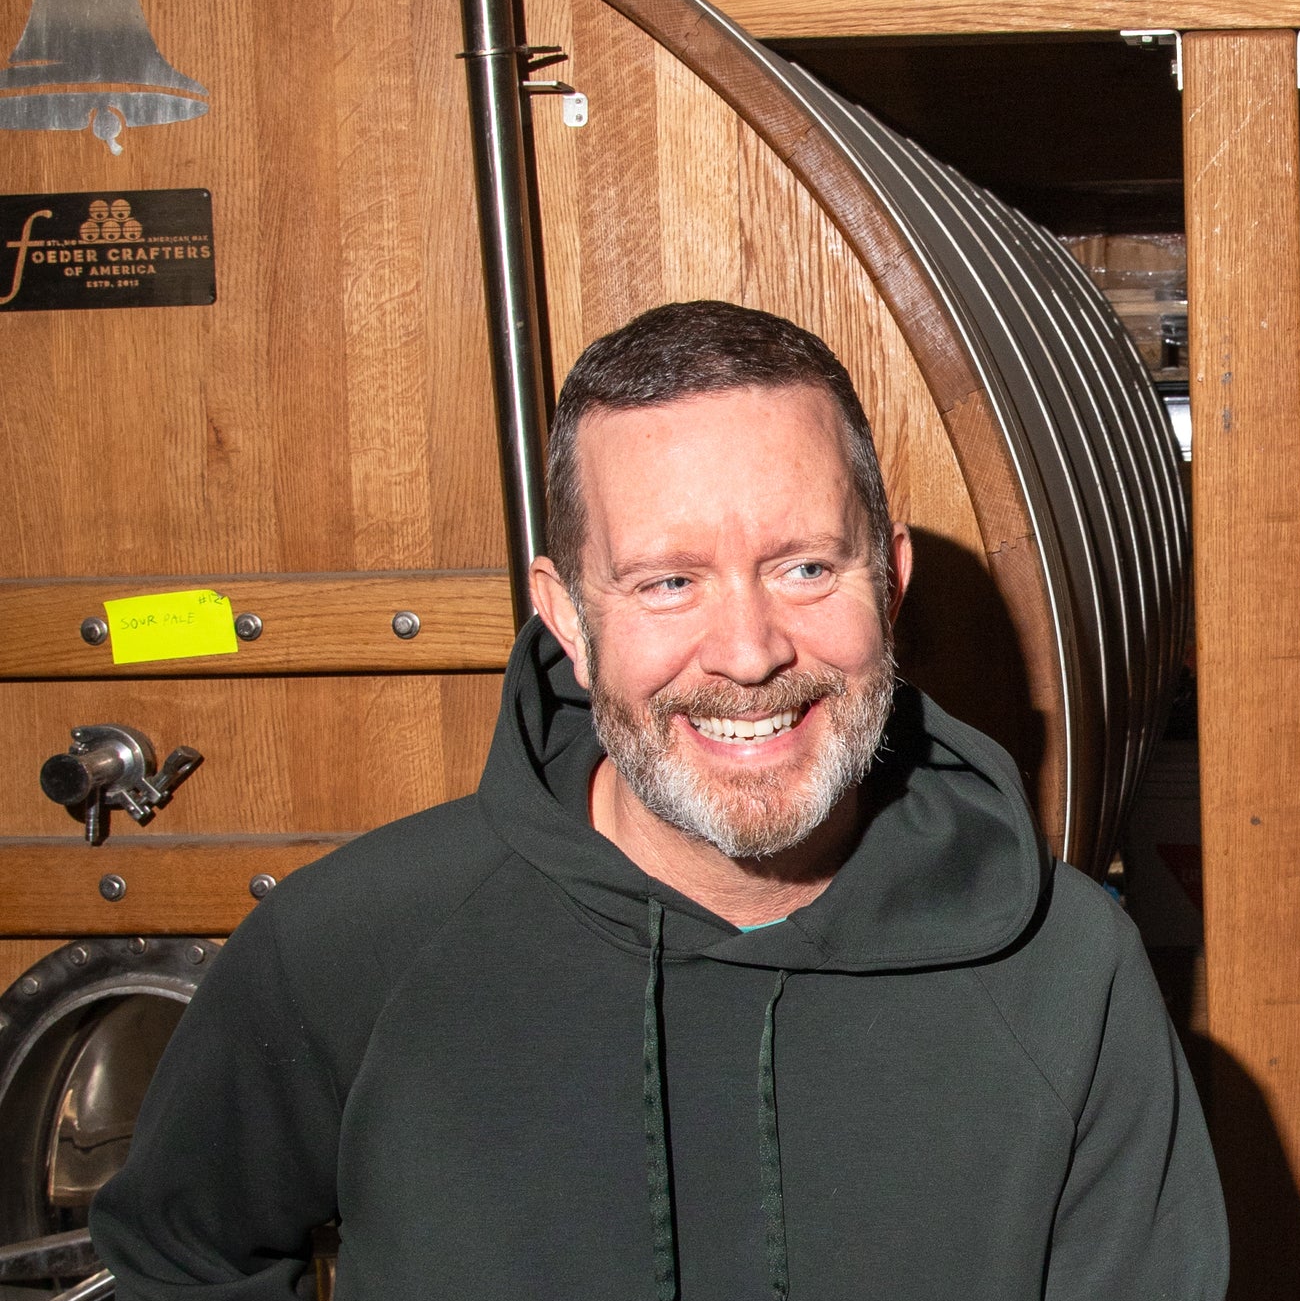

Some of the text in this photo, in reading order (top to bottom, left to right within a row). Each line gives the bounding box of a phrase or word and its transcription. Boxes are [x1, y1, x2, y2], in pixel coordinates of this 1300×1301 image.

[107, 244, 211, 262] CRAFTERS
[64, 263, 157, 277] OF AMERICA
[120, 612, 196, 630] SOUR PALE
